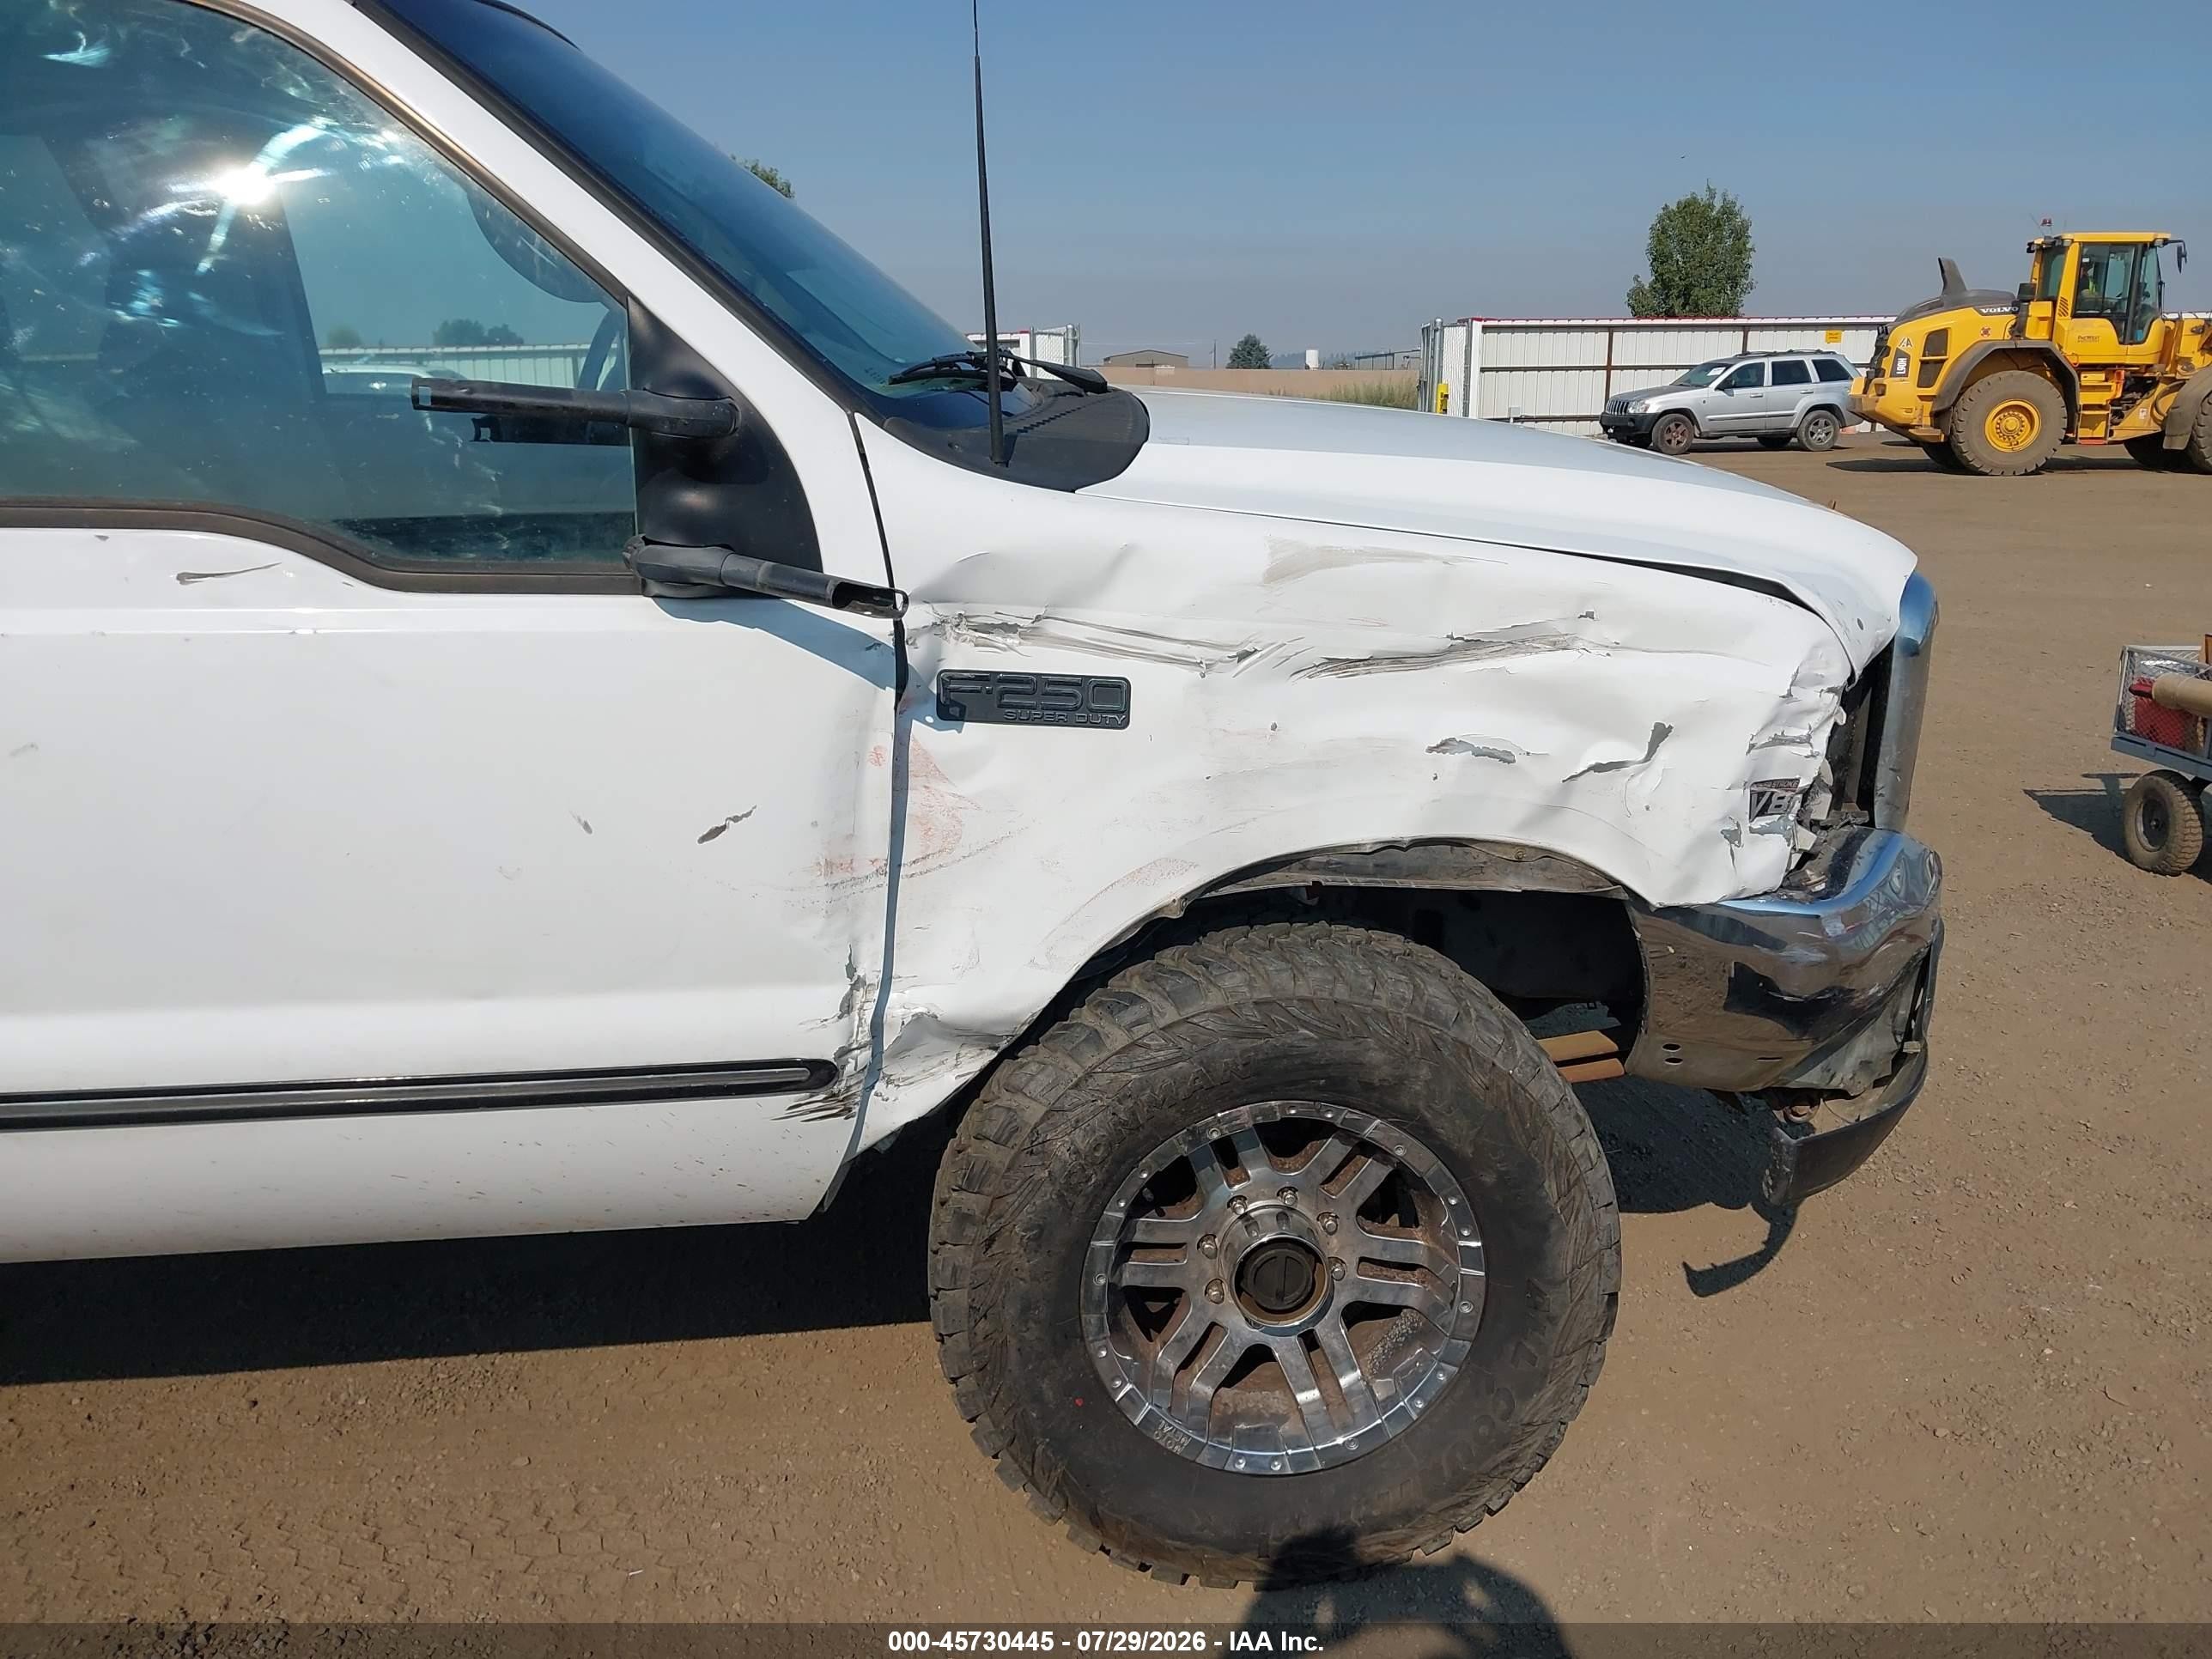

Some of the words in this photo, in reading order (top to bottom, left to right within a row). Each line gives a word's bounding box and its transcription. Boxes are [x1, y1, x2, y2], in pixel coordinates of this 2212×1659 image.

[1896, 357, 1907, 374] L90H
[1003, 709, 1068, 722] SUPER
[1074, 713, 1126, 726] DUTY
